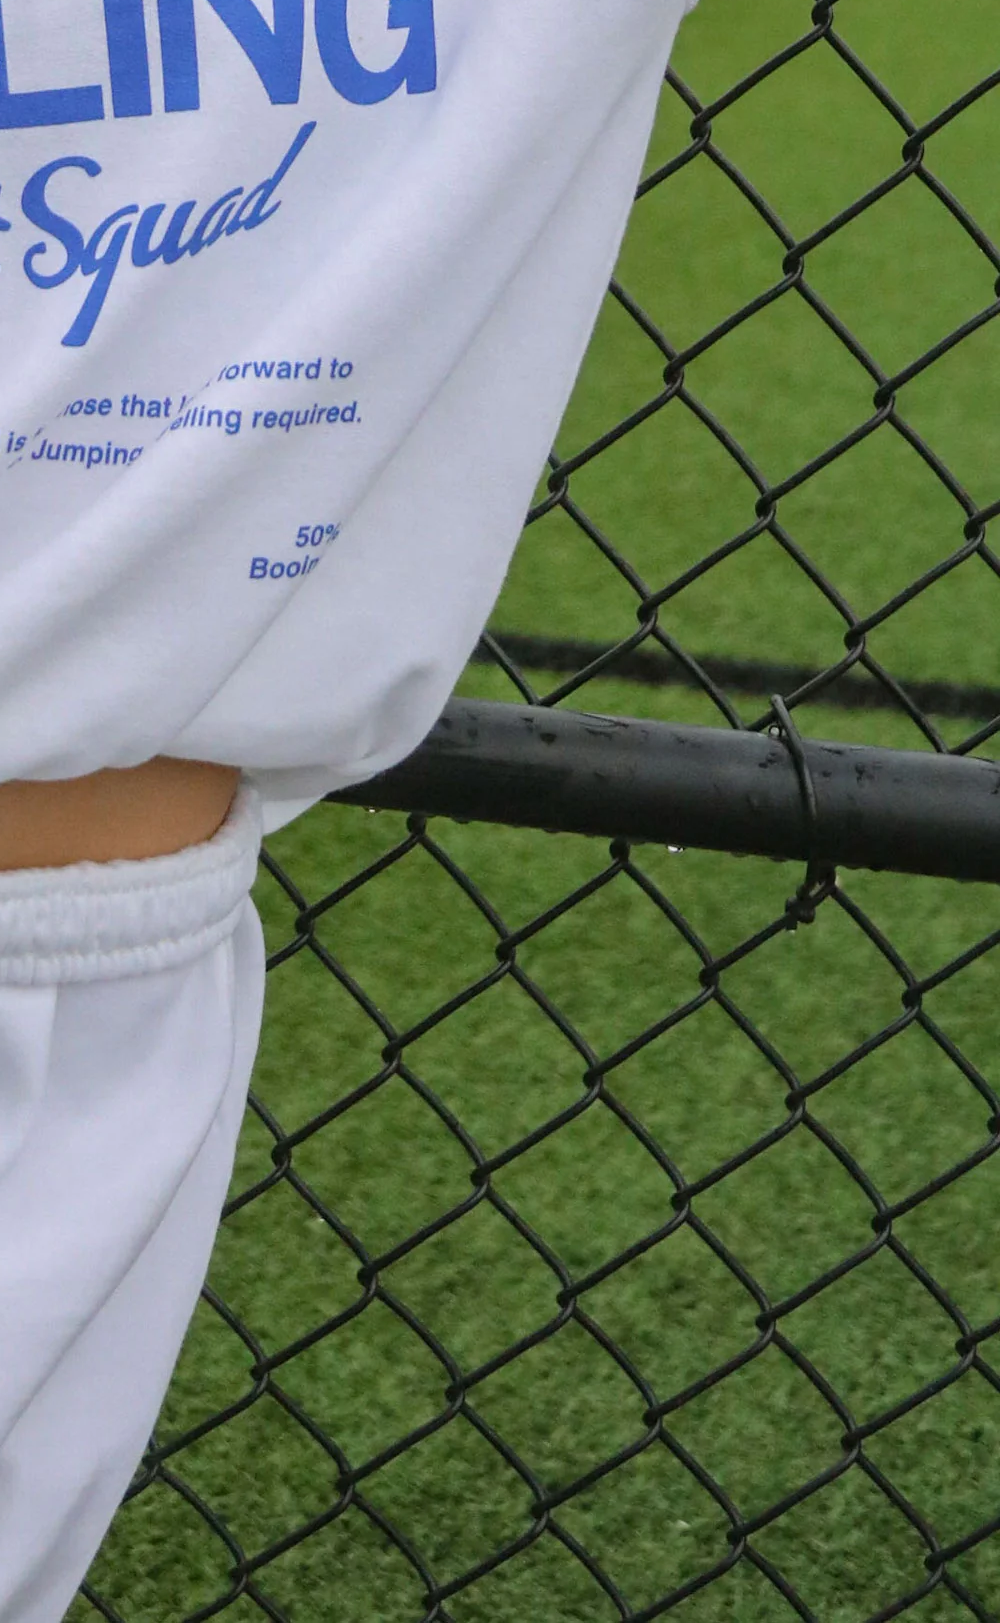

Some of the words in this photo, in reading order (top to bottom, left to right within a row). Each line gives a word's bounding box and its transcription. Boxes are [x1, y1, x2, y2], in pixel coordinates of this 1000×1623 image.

[23, 120, 317, 347] Squad
[6, 431, 28, 454] is
[120, 393, 174, 418] that
[217, 356, 323, 382] orward
[330, 357, 354, 380] to
[31, 438, 145, 469] Jumping
[252, 401, 362, 433] required.
